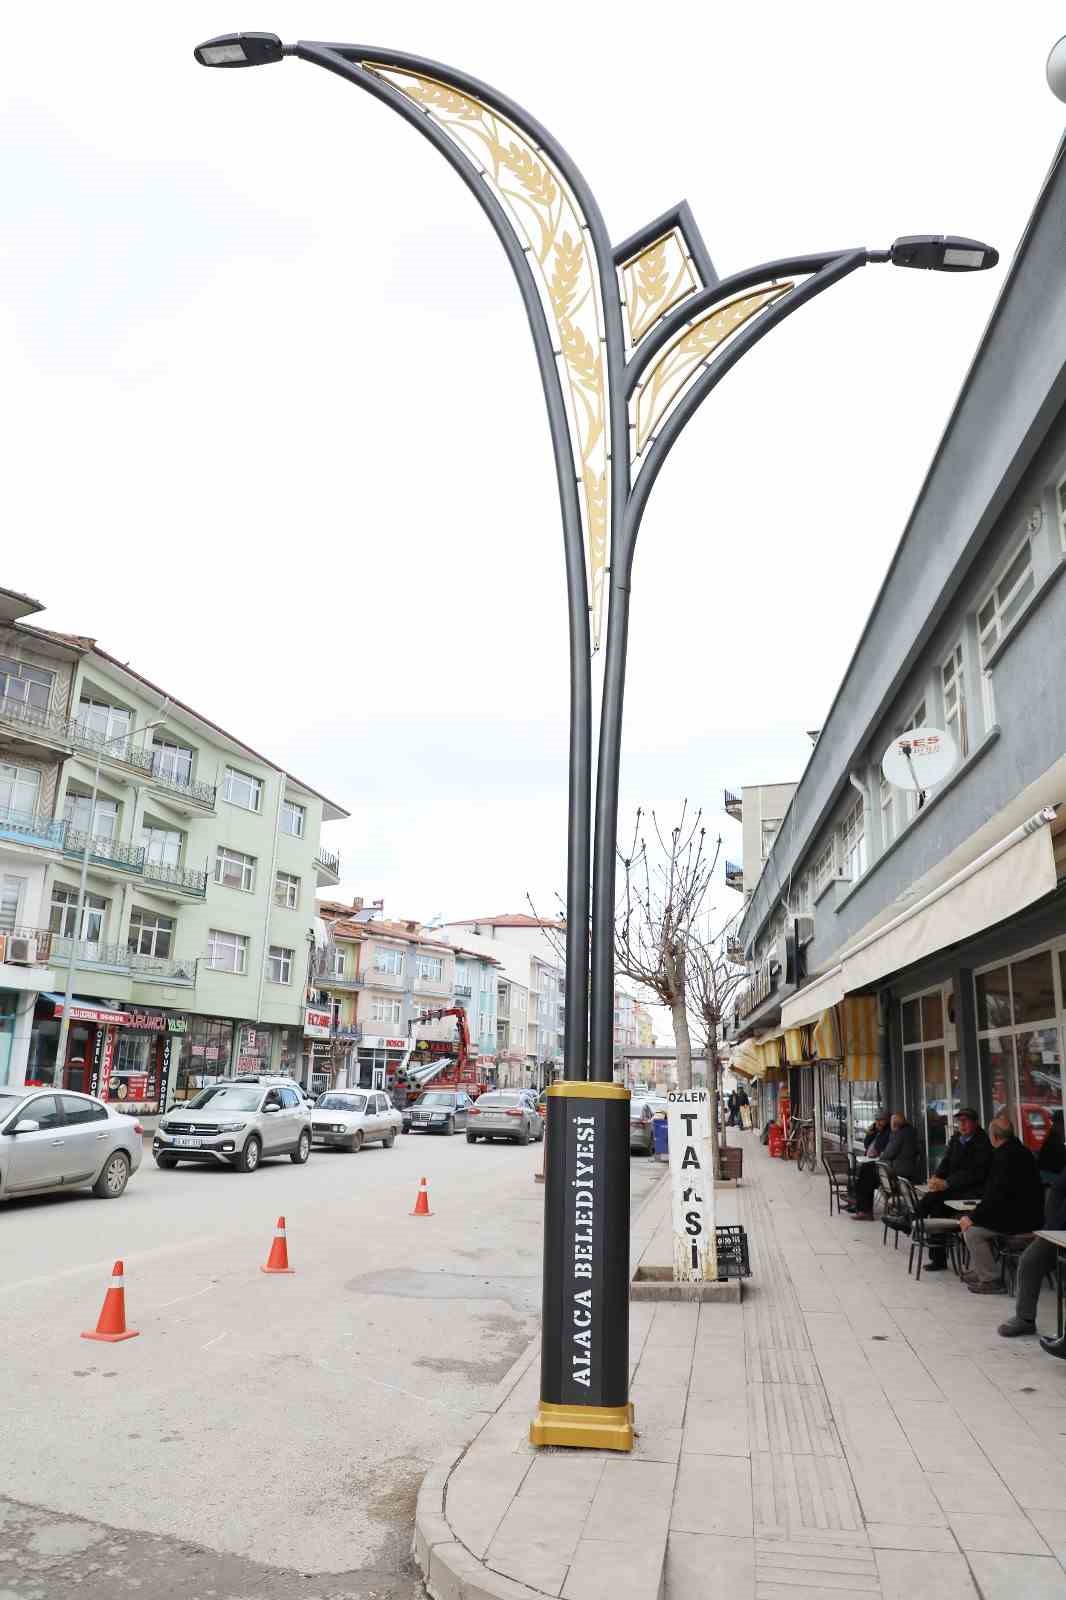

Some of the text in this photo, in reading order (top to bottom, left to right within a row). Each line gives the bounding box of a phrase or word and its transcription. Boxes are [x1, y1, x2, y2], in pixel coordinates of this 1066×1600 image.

[386, 1039, 405, 1048] BOSCH
[571, 1116, 595, 1388] ALACA BELEDİYESİ
